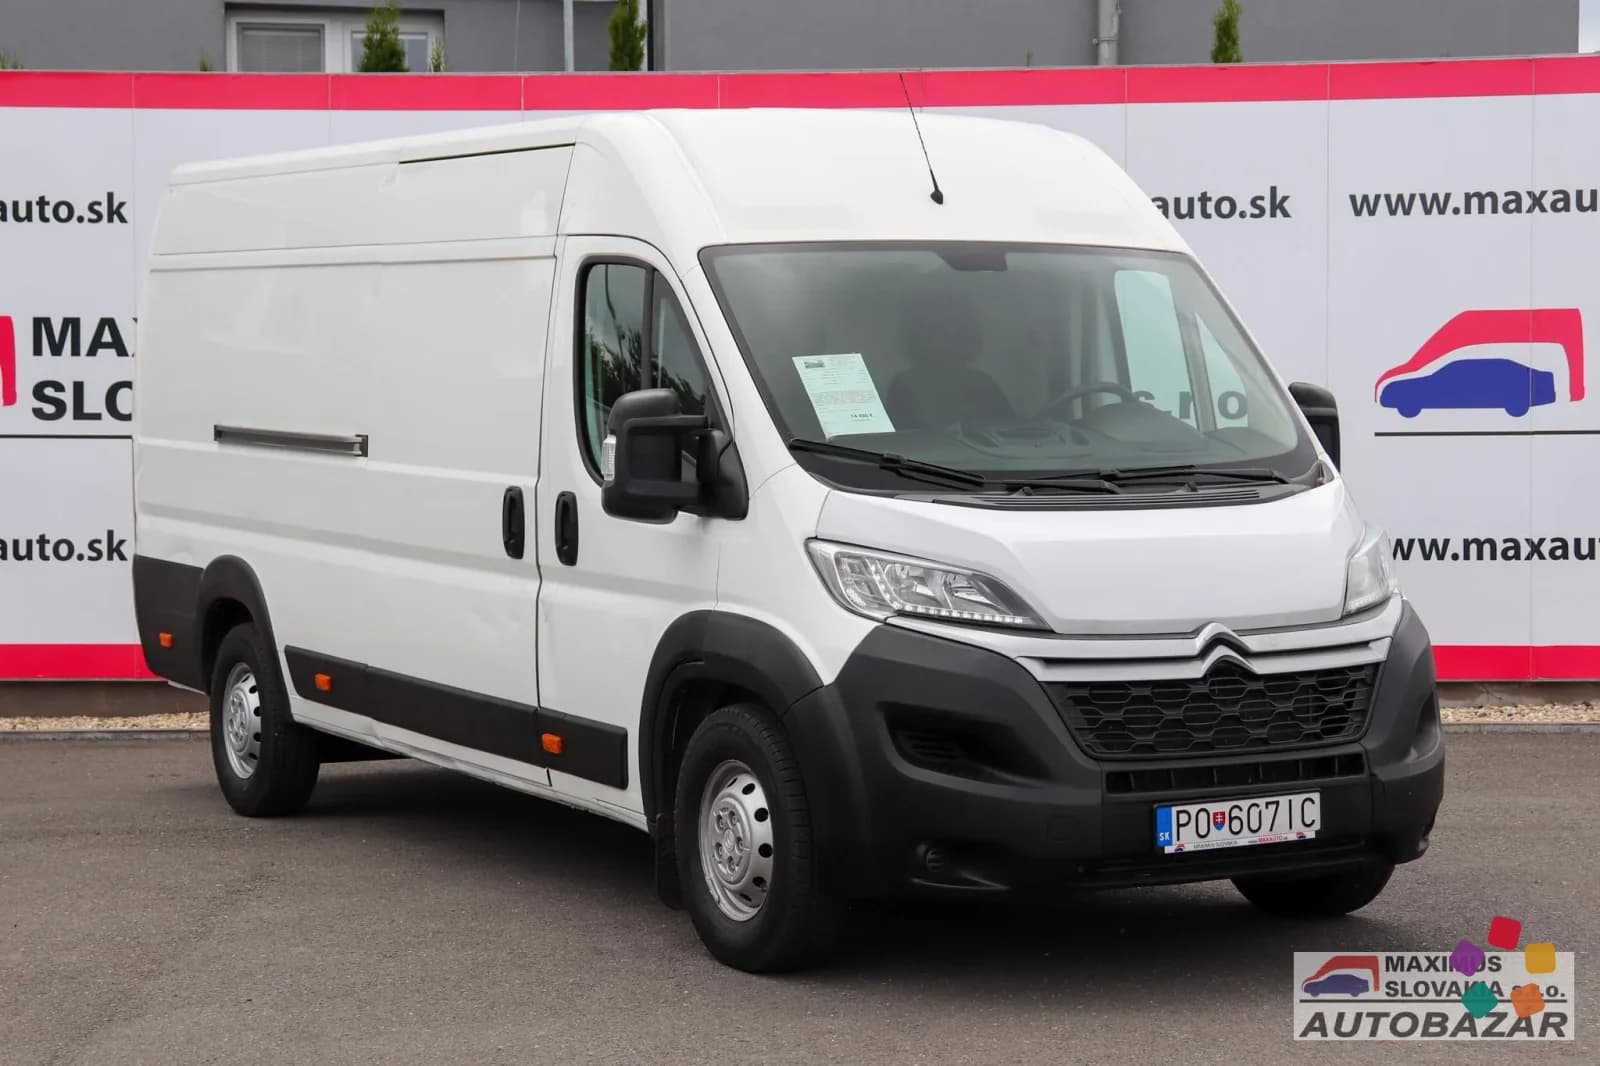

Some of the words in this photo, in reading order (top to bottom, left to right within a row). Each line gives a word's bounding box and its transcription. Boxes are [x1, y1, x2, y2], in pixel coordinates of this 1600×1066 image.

[1348, 188, 1599, 217] www.maxau
[32, 317, 138, 357] MA
[1391, 537, 1600, 562] ww.maxau
[1159, 832, 1170, 841] SK
[1175, 807, 1211, 842] PO
